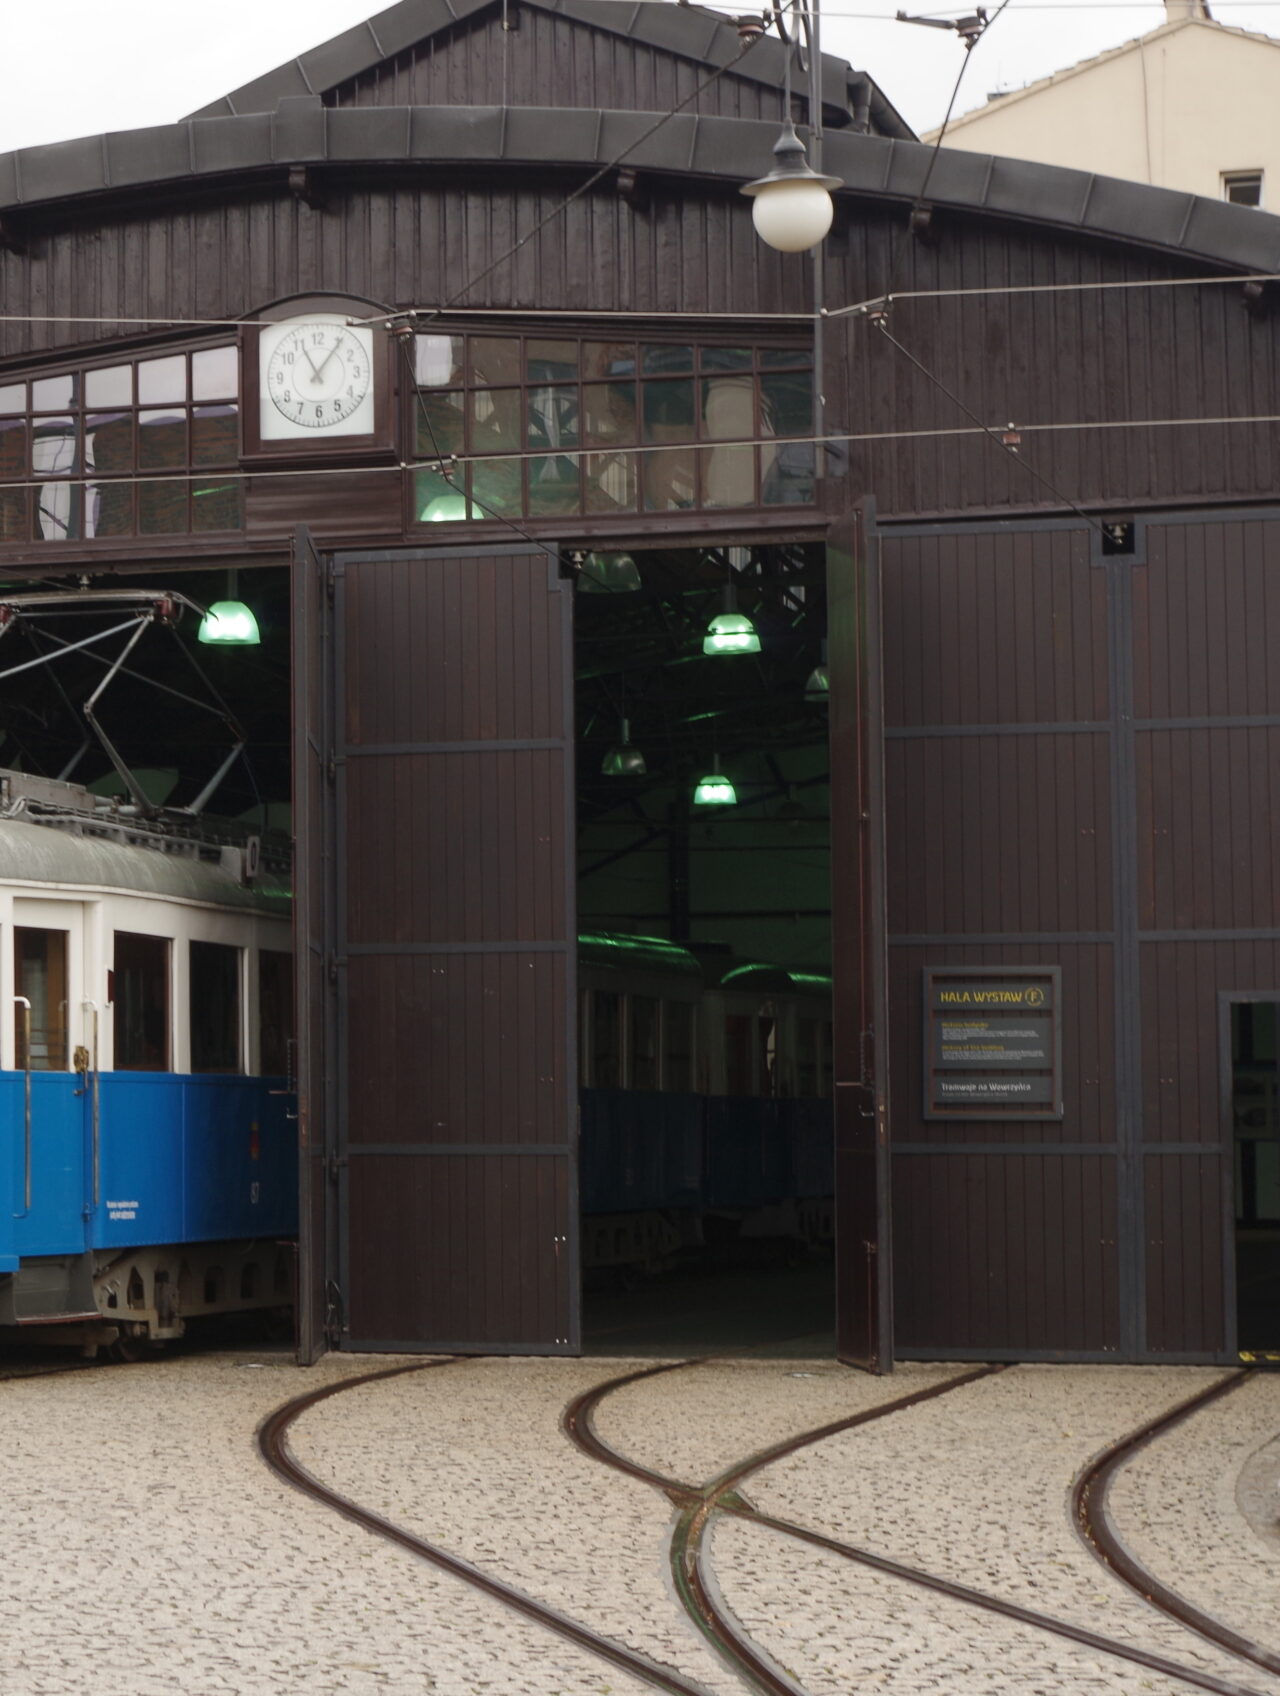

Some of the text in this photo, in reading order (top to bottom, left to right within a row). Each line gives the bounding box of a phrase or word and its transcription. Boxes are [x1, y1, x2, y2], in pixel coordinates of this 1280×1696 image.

[312, 332, 325, 346] 12
[282, 352, 294, 365] 10
[347, 350, 354, 361] 2
[277, 372, 284, 385] 9
[353, 367, 360, 379] 3
[284, 390, 291, 403] 8
[347, 385, 353, 398] 4
[297, 402, 304, 415] 7
[315, 405, 323, 418] 6
[334, 400, 341, 412] 5
[940, 991, 970, 1003] HALA
[973, 991, 1022, 1003] WYSTAW
[941, 1083, 977, 1092] Tramwaje
